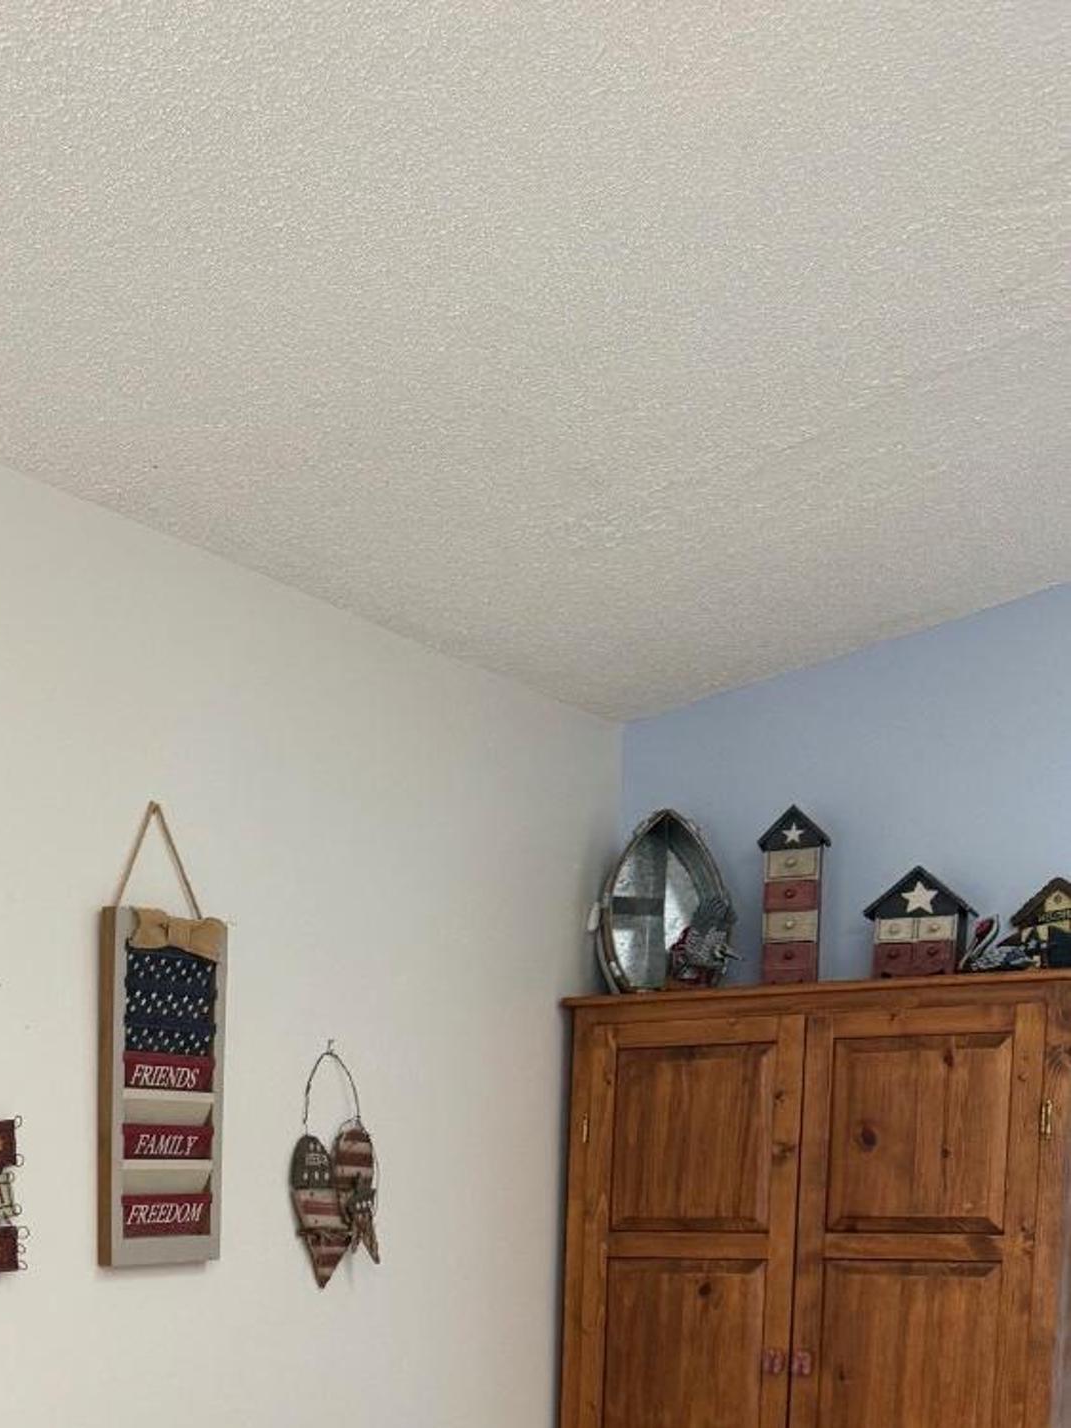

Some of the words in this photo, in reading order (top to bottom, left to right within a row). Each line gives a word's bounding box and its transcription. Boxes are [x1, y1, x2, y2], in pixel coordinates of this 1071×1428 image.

[131, 1064, 200, 1089] FRIENDS
[134, 1134, 198, 1156] FAMILY
[127, 1203, 203, 1225] FREEDOM
